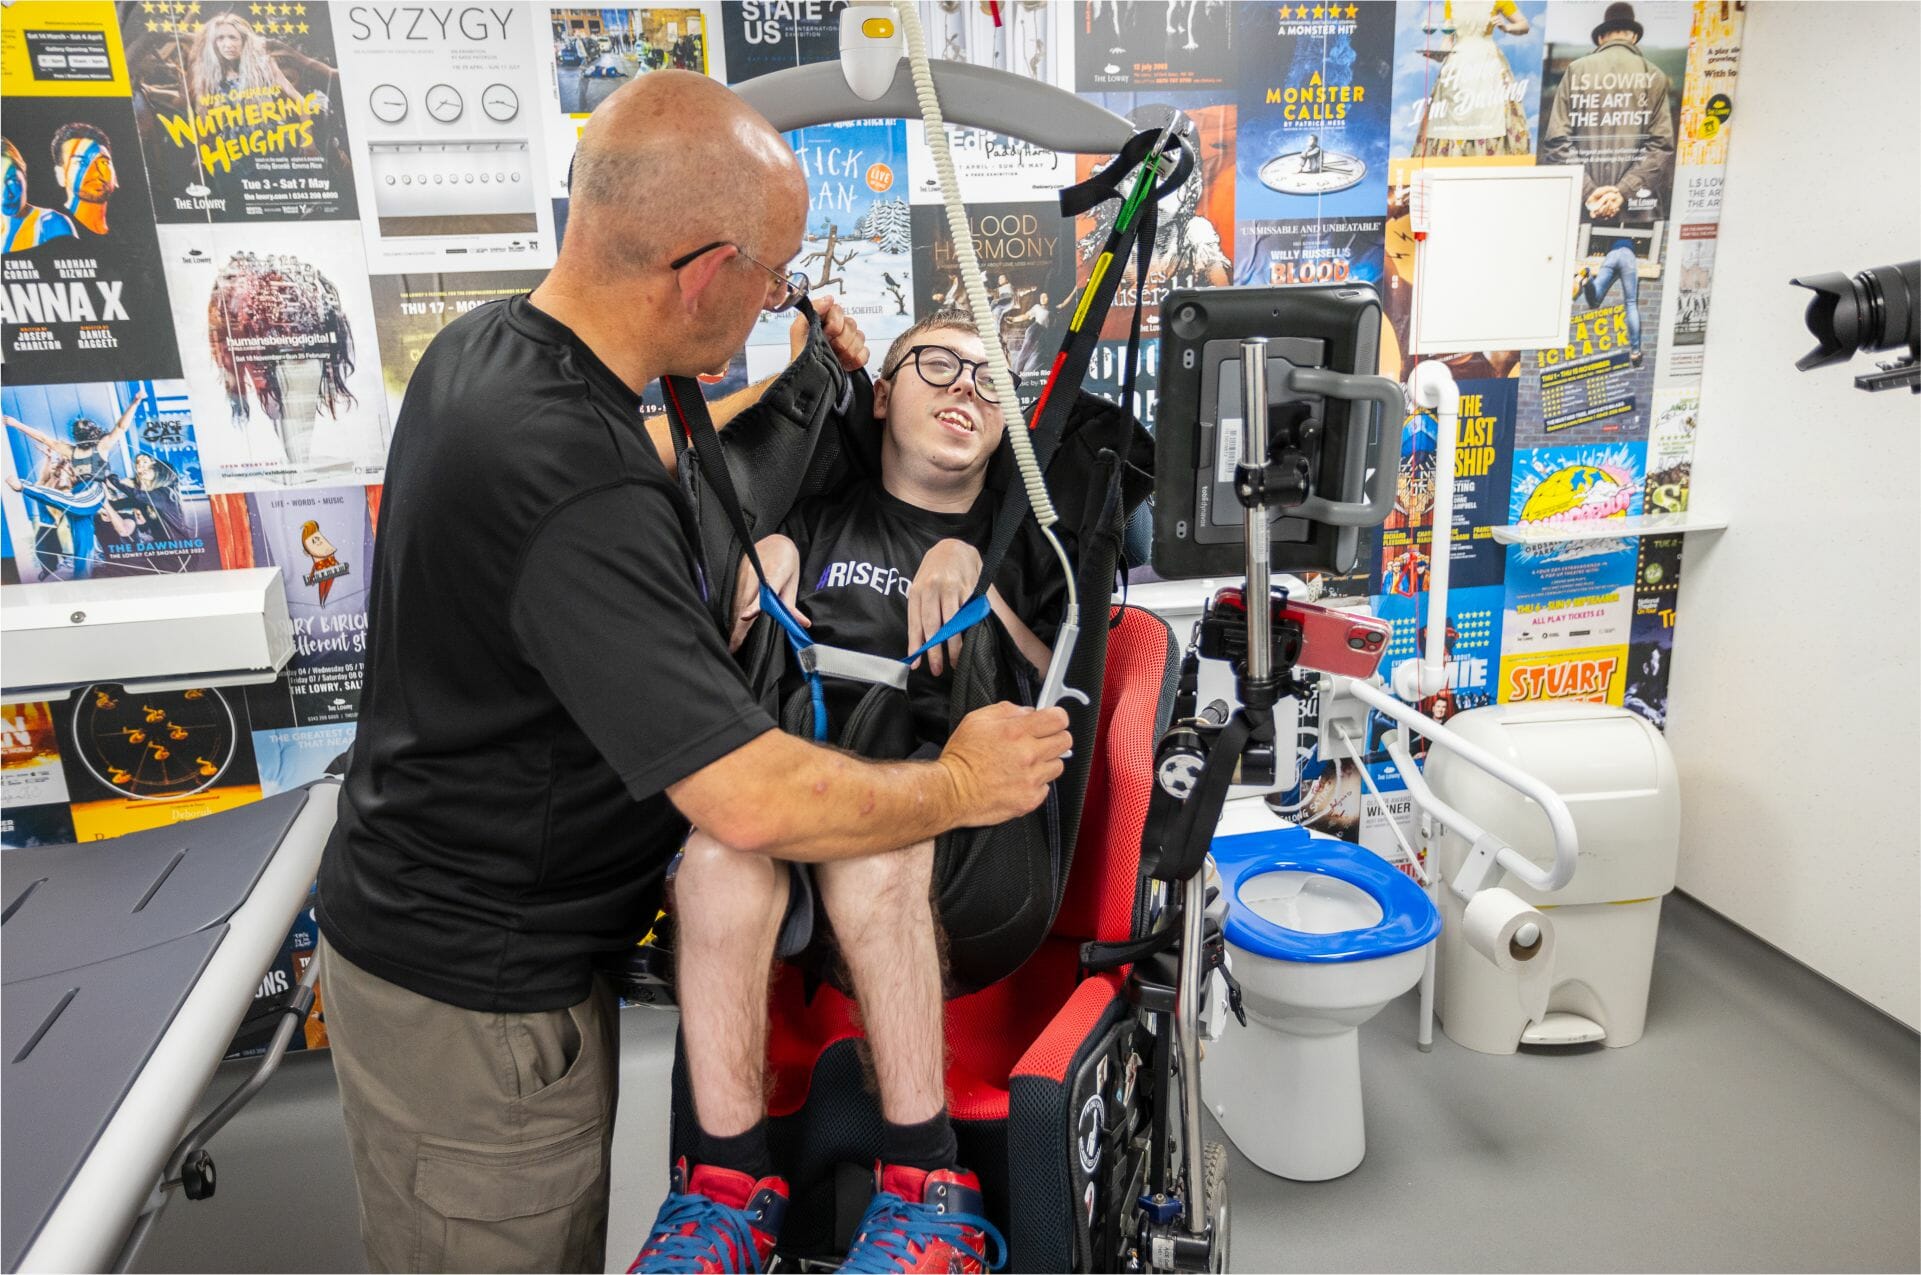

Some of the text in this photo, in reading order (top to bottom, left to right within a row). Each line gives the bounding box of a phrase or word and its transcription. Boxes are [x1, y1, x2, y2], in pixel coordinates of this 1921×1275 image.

[349, 6, 514, 41] SYZYGY
[1287, 25, 1336, 36] MONSTER
[744, 21, 781, 44] US
[1107, 75, 1129, 84] LOWRY
[1309, 70, 1322, 86] A
[1571, 72, 1656, 91] LS LOWRY
[1265, 86, 1365, 104] MONSTER
[1570, 93, 1649, 109] THE ART &
[1283, 103, 1346, 121] CALLS
[1568, 110, 1652, 128] THE ARTIST
[157, 92, 321, 149] WUTHERING
[201, 119, 315, 177] HEIGHTS
[795, 146, 863, 178] TICK
[870, 168, 891, 184] LIVE
[241, 177, 330, 191] Tue 3 Sat 7 May
[173, 198, 226, 211] THE LOWRY
[969, 214, 1038, 237] LOOD
[1300, 225, 1321, 234] AND
[934, 237, 1058, 261] HRMONY
[1270, 247, 1352, 261] WILLY RUSSELL'S
[4, 260, 35, 270] EMMA
[1270, 259, 1349, 286] BLOOD
[3, 268, 96, 280] CORRIN RIZWAN
[0, 280, 131, 324] ANNA X
[400, 302, 427, 315] THU
[429, 301, 445, 314] 17
[1576, 311, 1628, 342] ACK
[18, 329, 113, 341] JOSEPH DANIEL
[226, 333, 329, 347] humansbeingdigital
[13, 340, 62, 351] CHARLTON
[305, 352, 331, 360] February
[1458, 394, 1483, 417] THE
[1455, 416, 1497, 448] LAST
[1453, 447, 1496, 478] SHIP
[271, 496, 345, 509] LIFE WORDS MUSIC
[107, 538, 205, 553] THE DAWNING
[1532, 616, 1546, 625] ALL
[1547, 614, 1567, 624] PLAY
[1568, 611, 1595, 621] TICKETS
[312, 665, 344, 675] Wednesday
[345, 663, 354, 671] 05
[321, 672, 348, 682] Saturday
[1509, 656, 1619, 702] STUART
[290, 685, 307, 695] THE
[292, 728, 347, 742] GREATEST
[297, 739, 325, 749] THAT
[1367, 802, 1411, 817] WINER
